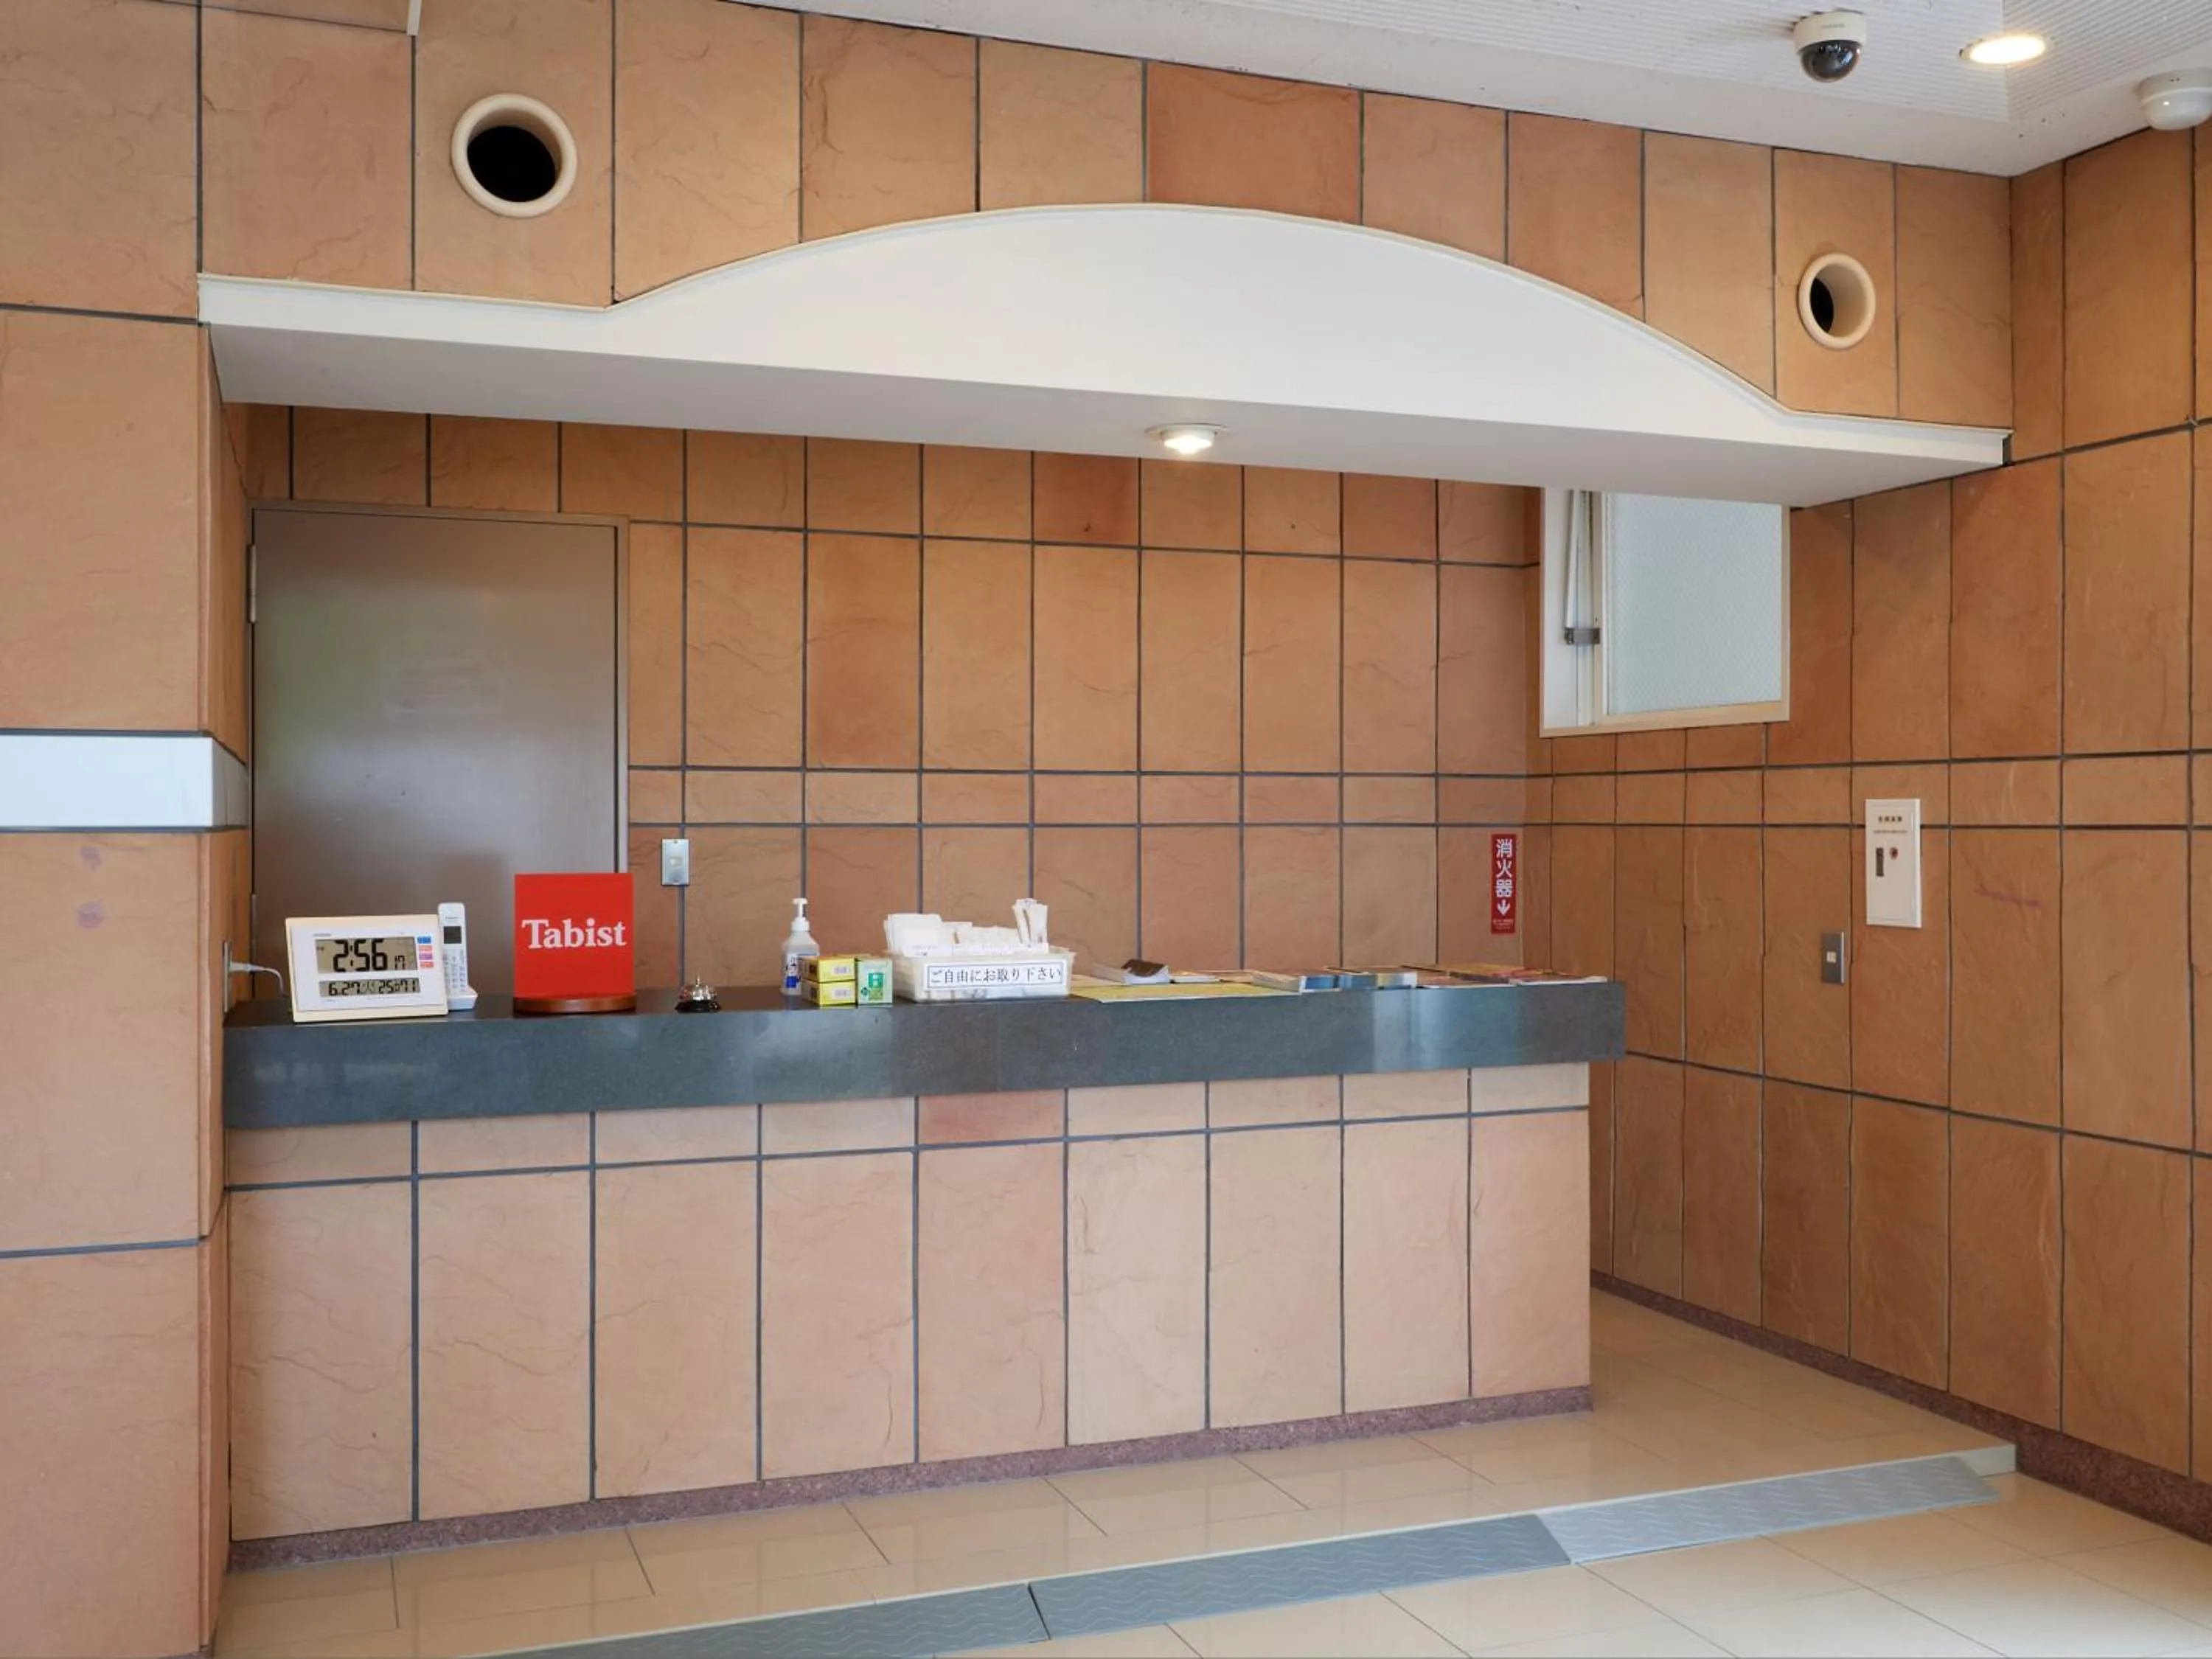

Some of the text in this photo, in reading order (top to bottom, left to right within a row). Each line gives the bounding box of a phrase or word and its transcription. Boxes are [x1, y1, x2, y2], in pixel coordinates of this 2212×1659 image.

[1496, 838, 1513, 897] 消火器
[521, 917, 627, 949] Tabist
[333, 939, 388, 972] 2:56
[931, 966, 1062, 984] ご自由にお取り下さい
